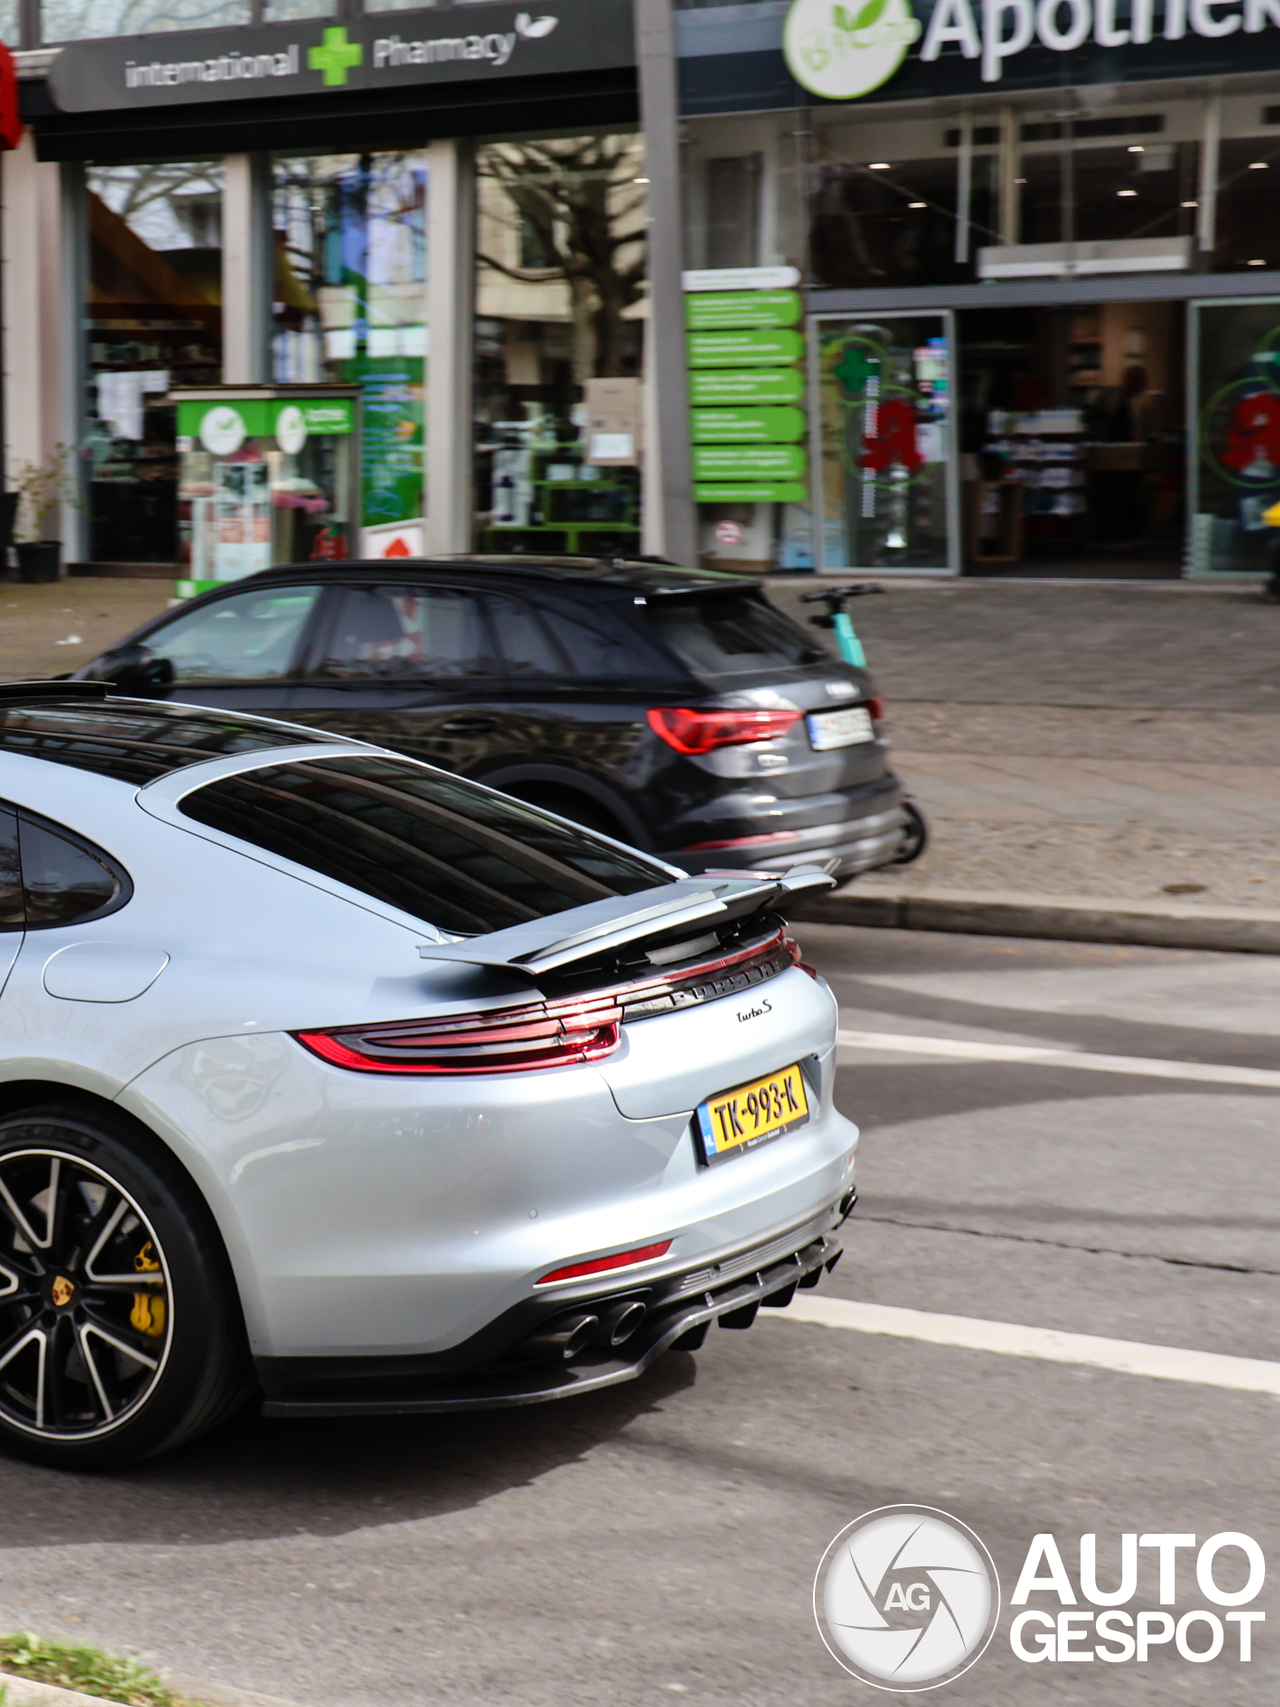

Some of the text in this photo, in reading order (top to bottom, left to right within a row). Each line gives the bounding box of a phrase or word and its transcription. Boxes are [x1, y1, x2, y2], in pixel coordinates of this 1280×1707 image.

[125, 31, 517, 88] international Pharmacy
[670, 959, 782, 1006] PORSCHE
[714, 1076, 799, 1142] TK-993-K
[704, 1135, 715, 1149] NL
